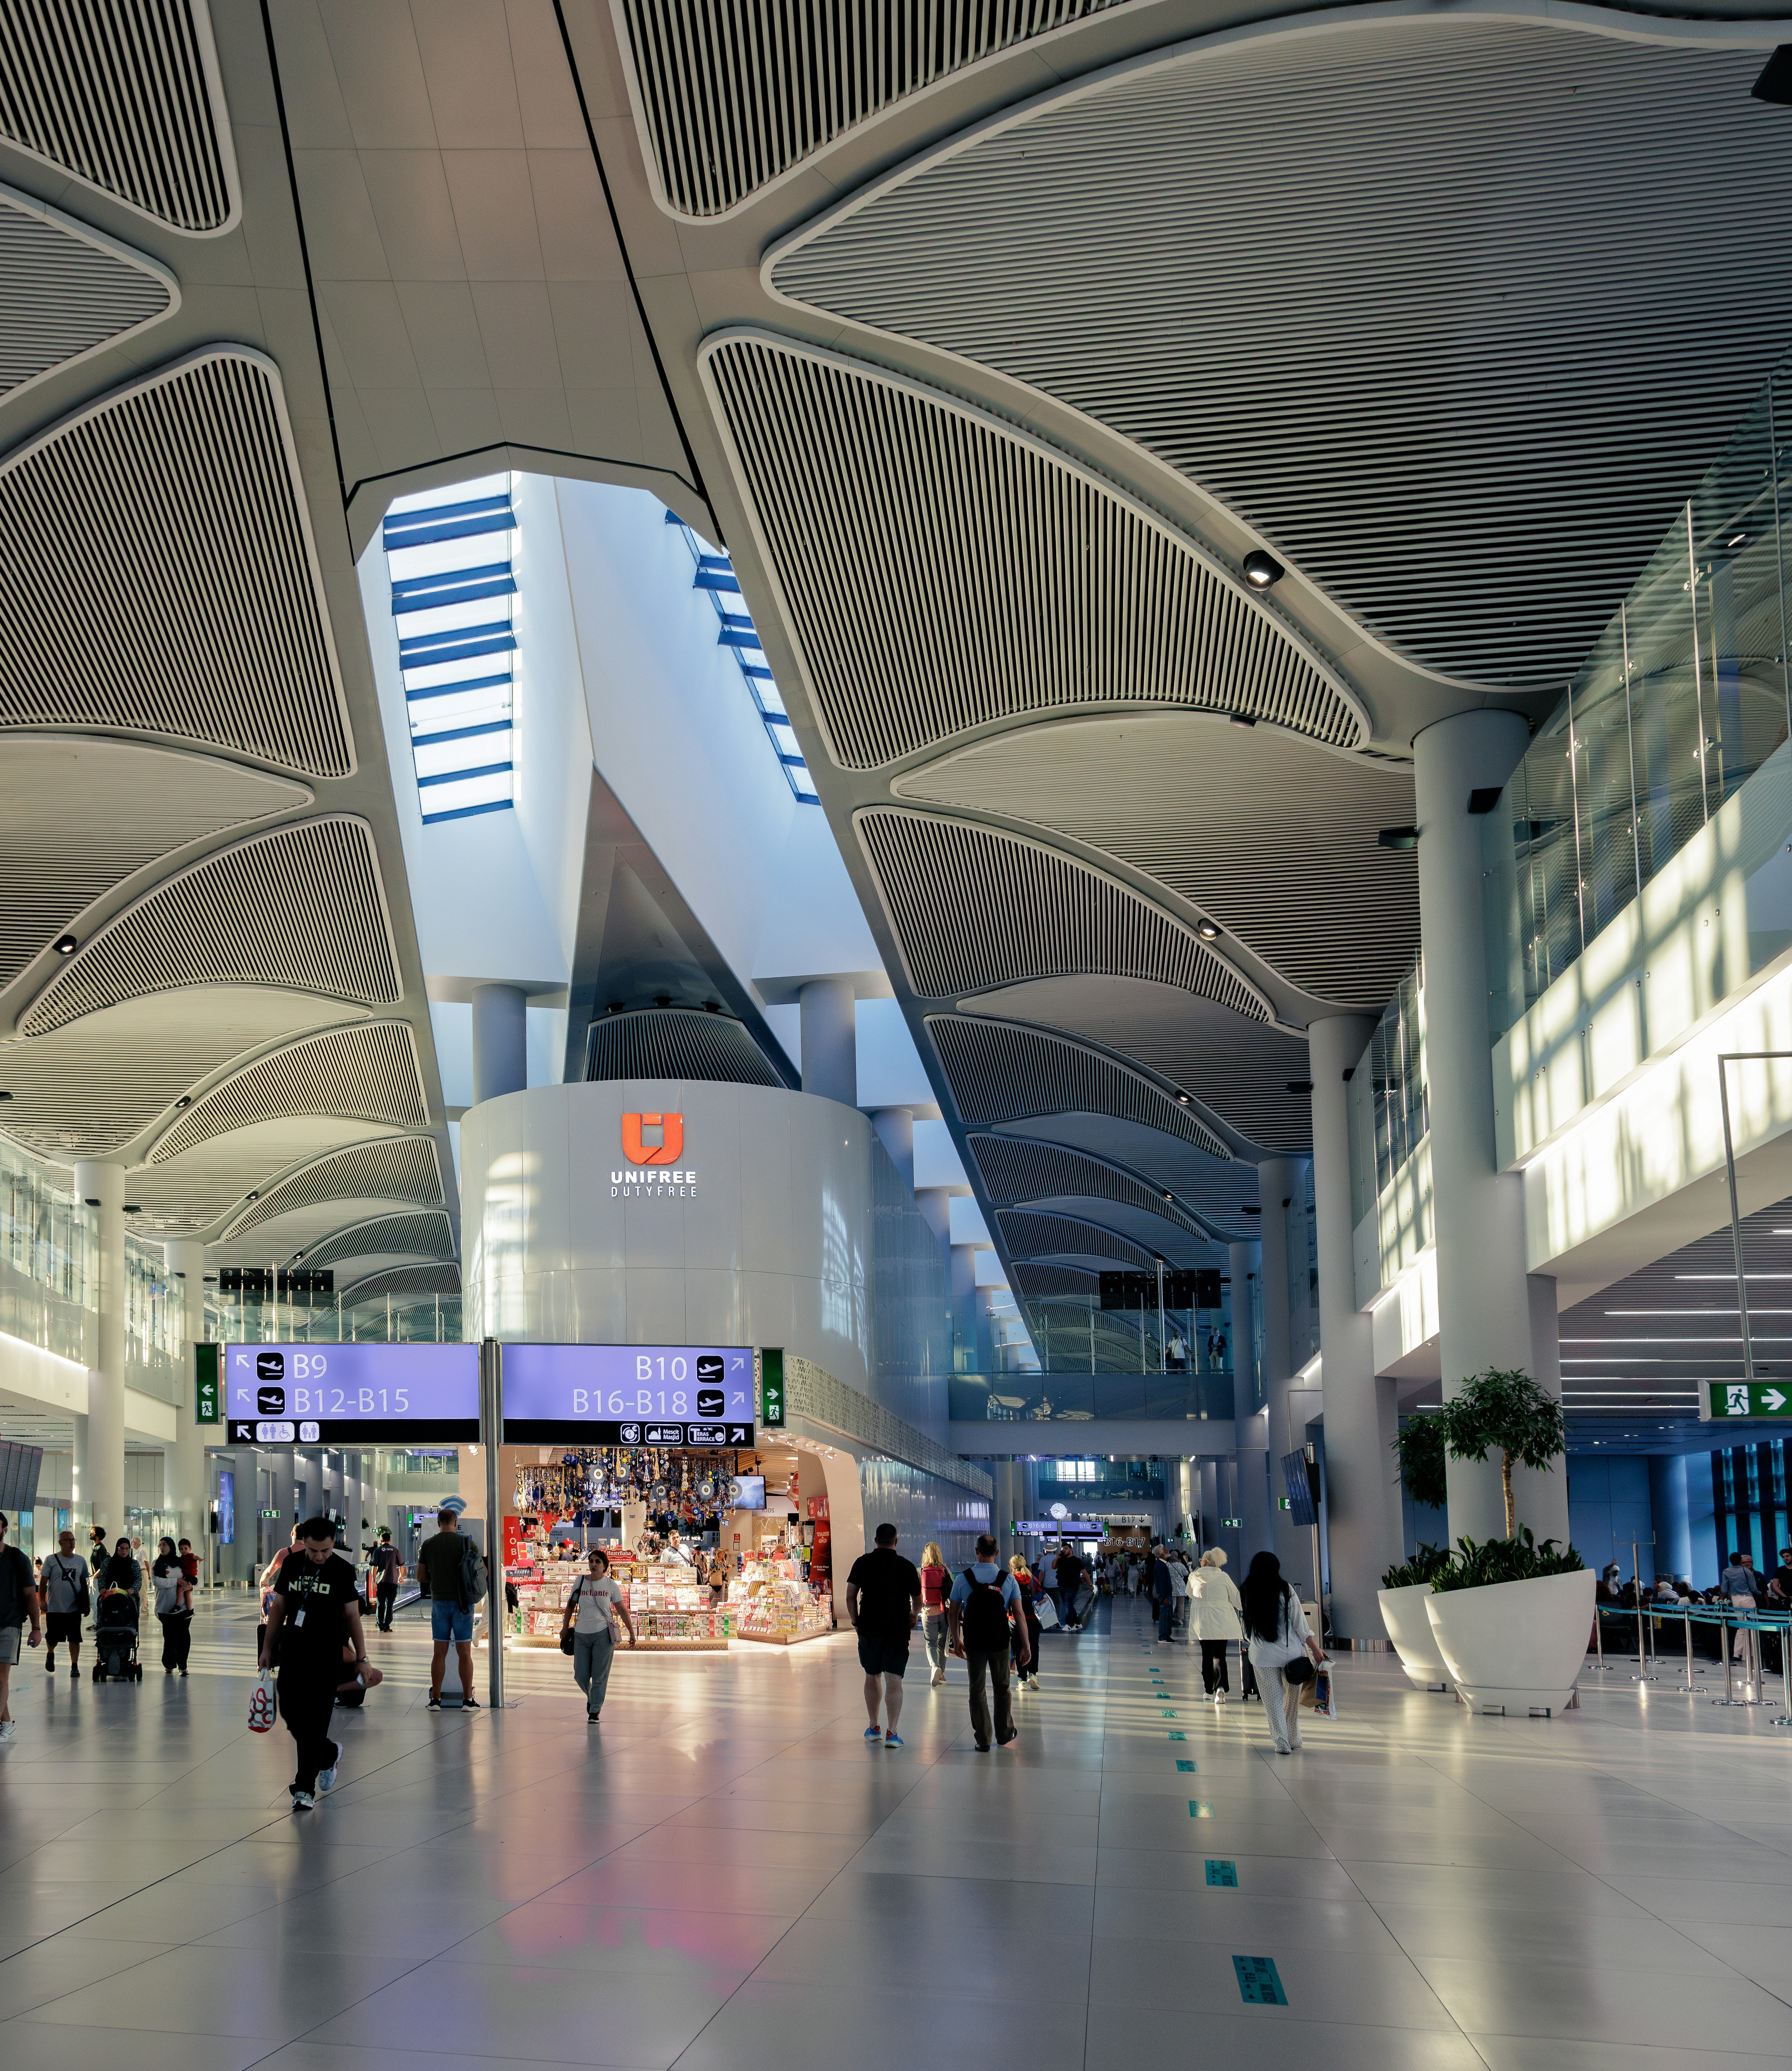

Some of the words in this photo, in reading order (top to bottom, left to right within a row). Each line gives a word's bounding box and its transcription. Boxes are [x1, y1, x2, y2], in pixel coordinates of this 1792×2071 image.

[611, 1171, 696, 1184] UNIFREE
[611, 1186, 696, 1197] DUTYFREE
[293, 1354, 327, 1378] B9
[636, 1356, 687, 1380] B10
[294, 1388, 409, 1412] B12-B15
[573, 1389, 687, 1415] B16-B18
[1104, 1537, 1145, 1546] B16-B17
